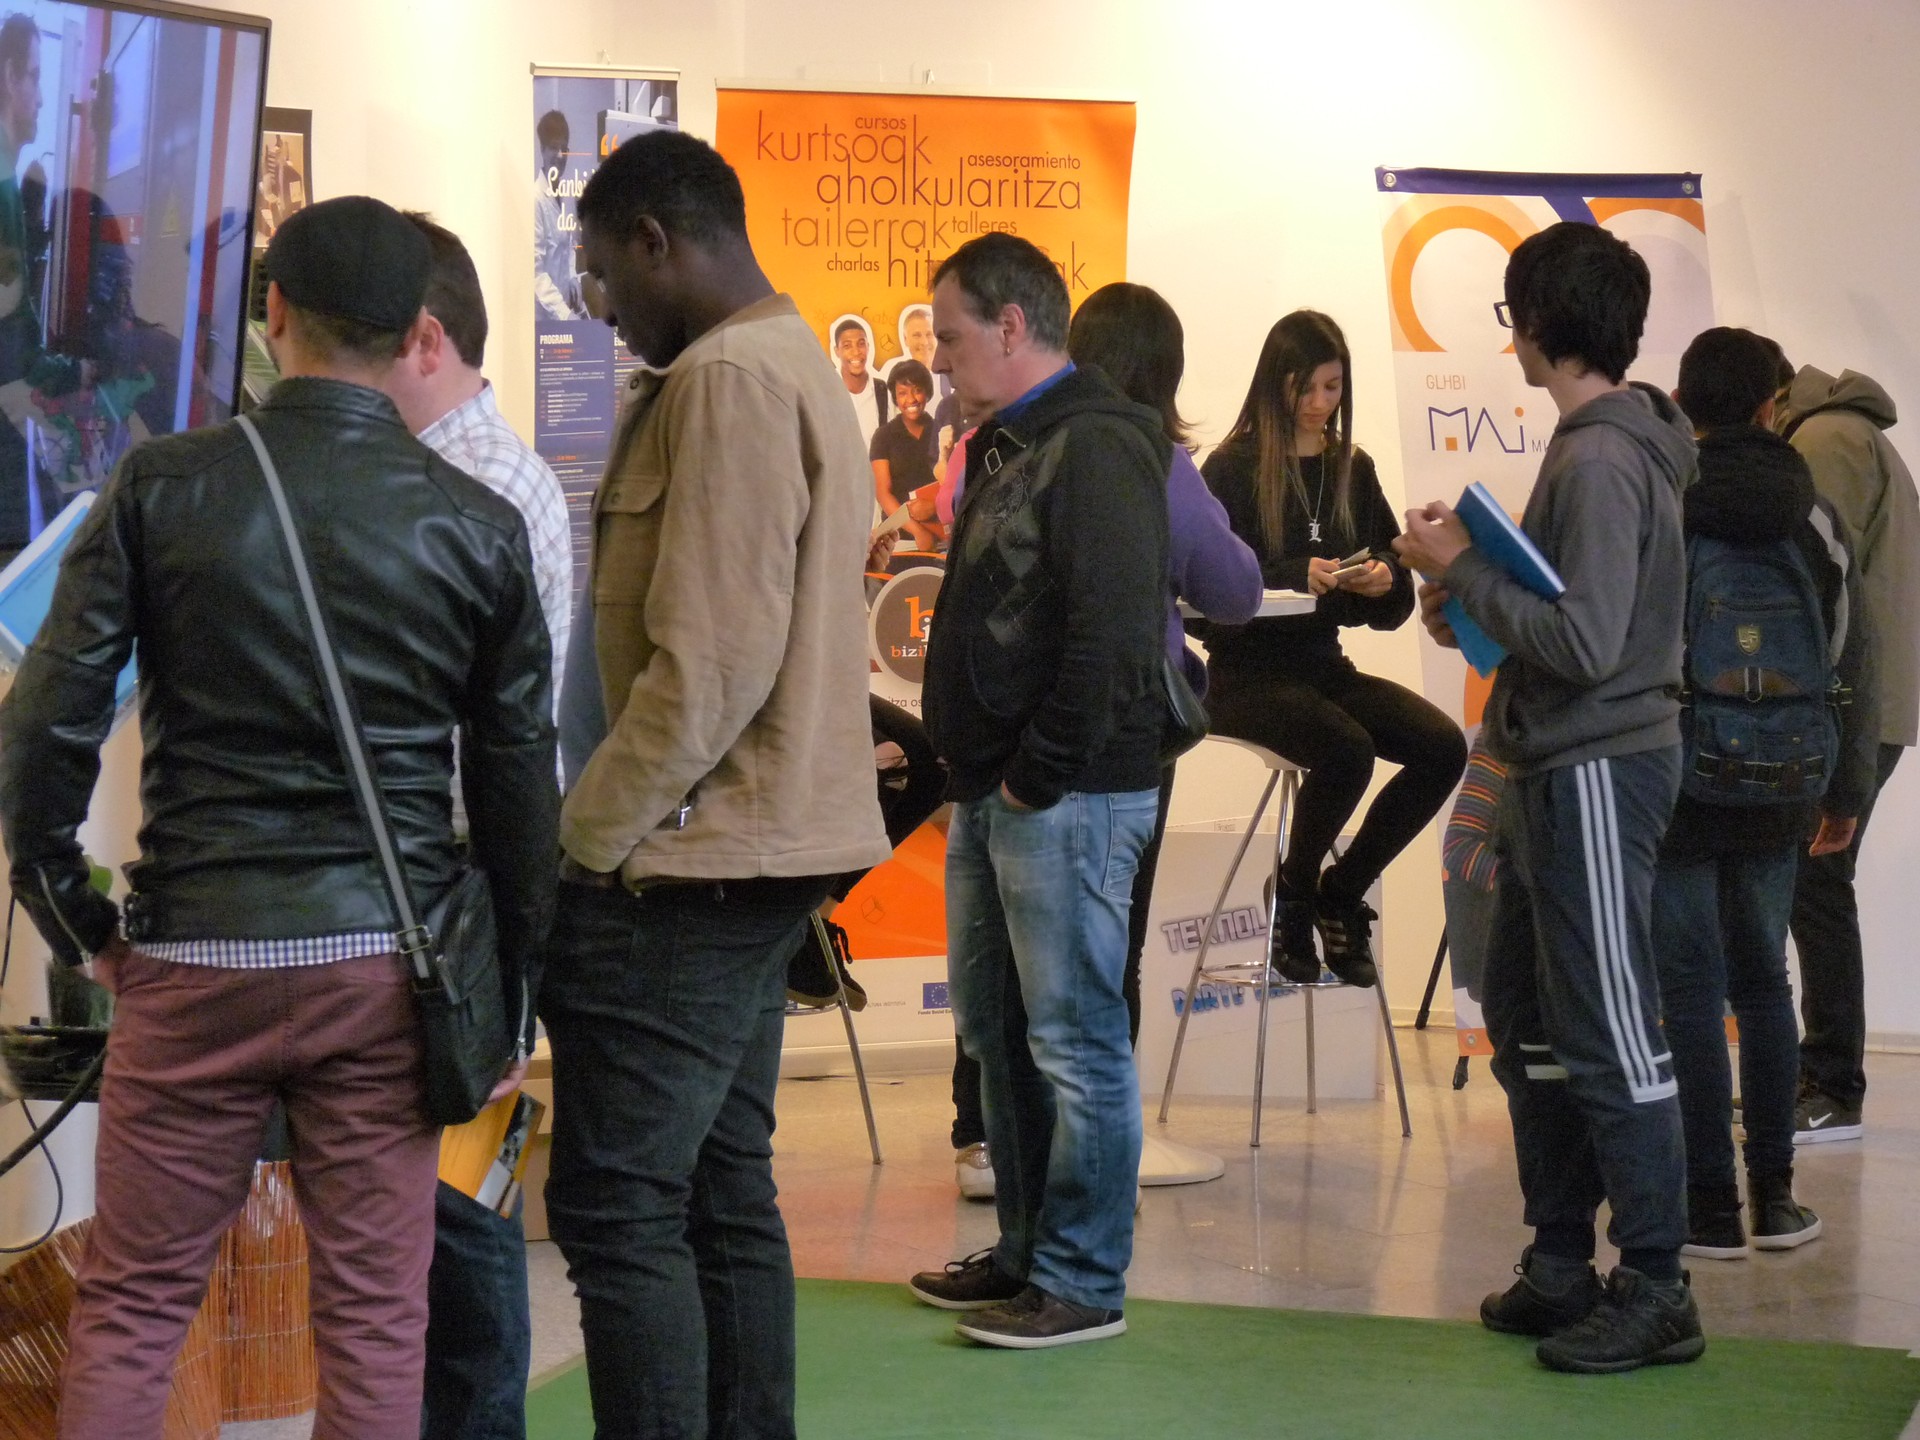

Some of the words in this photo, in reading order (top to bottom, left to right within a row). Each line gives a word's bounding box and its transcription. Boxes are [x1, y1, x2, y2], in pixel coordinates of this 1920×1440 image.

[854, 115, 907, 130] cursos
[758, 110, 932, 164] kurtsoak
[967, 151, 1081, 170] asesoramiento
[816, 153, 1081, 210] aholkularitza
[782, 199, 951, 249] tailerrak
[952, 211, 1017, 234] talleres
[826, 252, 880, 271] charlas
[539, 334, 574, 345] PROGRAMA
[1426, 374, 1466, 390] GLHBI
